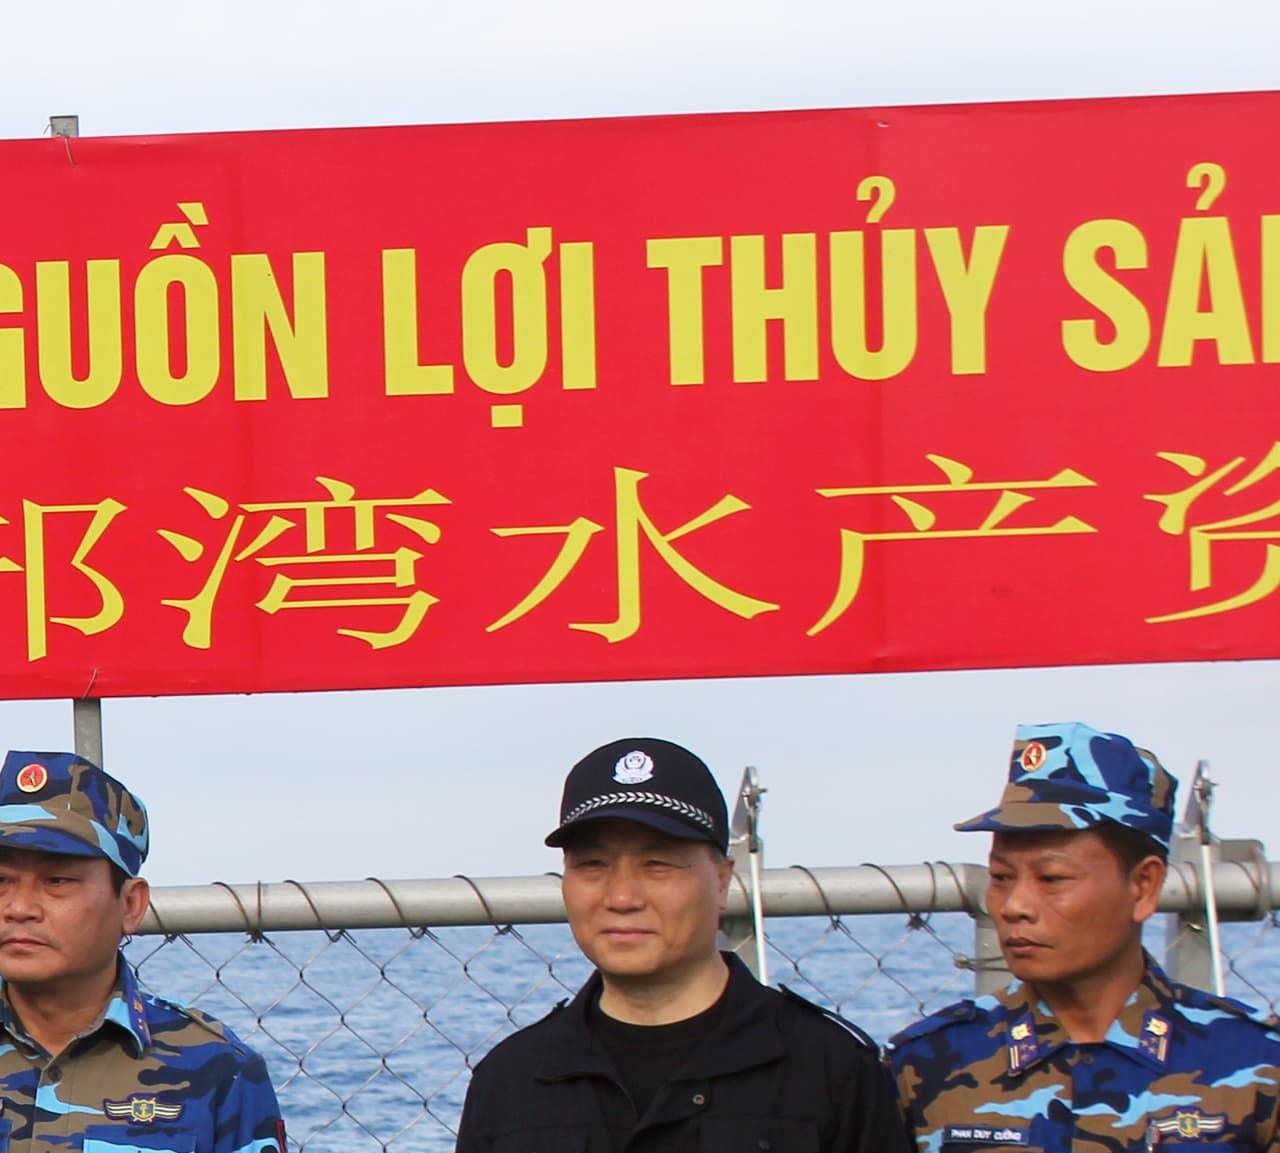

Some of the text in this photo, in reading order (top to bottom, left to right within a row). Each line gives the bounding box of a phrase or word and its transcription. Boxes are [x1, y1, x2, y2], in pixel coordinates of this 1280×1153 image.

[382, 227, 596, 428] LỢI
[646, 175, 1009, 385] THỦY
[1061, 162, 1280, 371] SẢ
